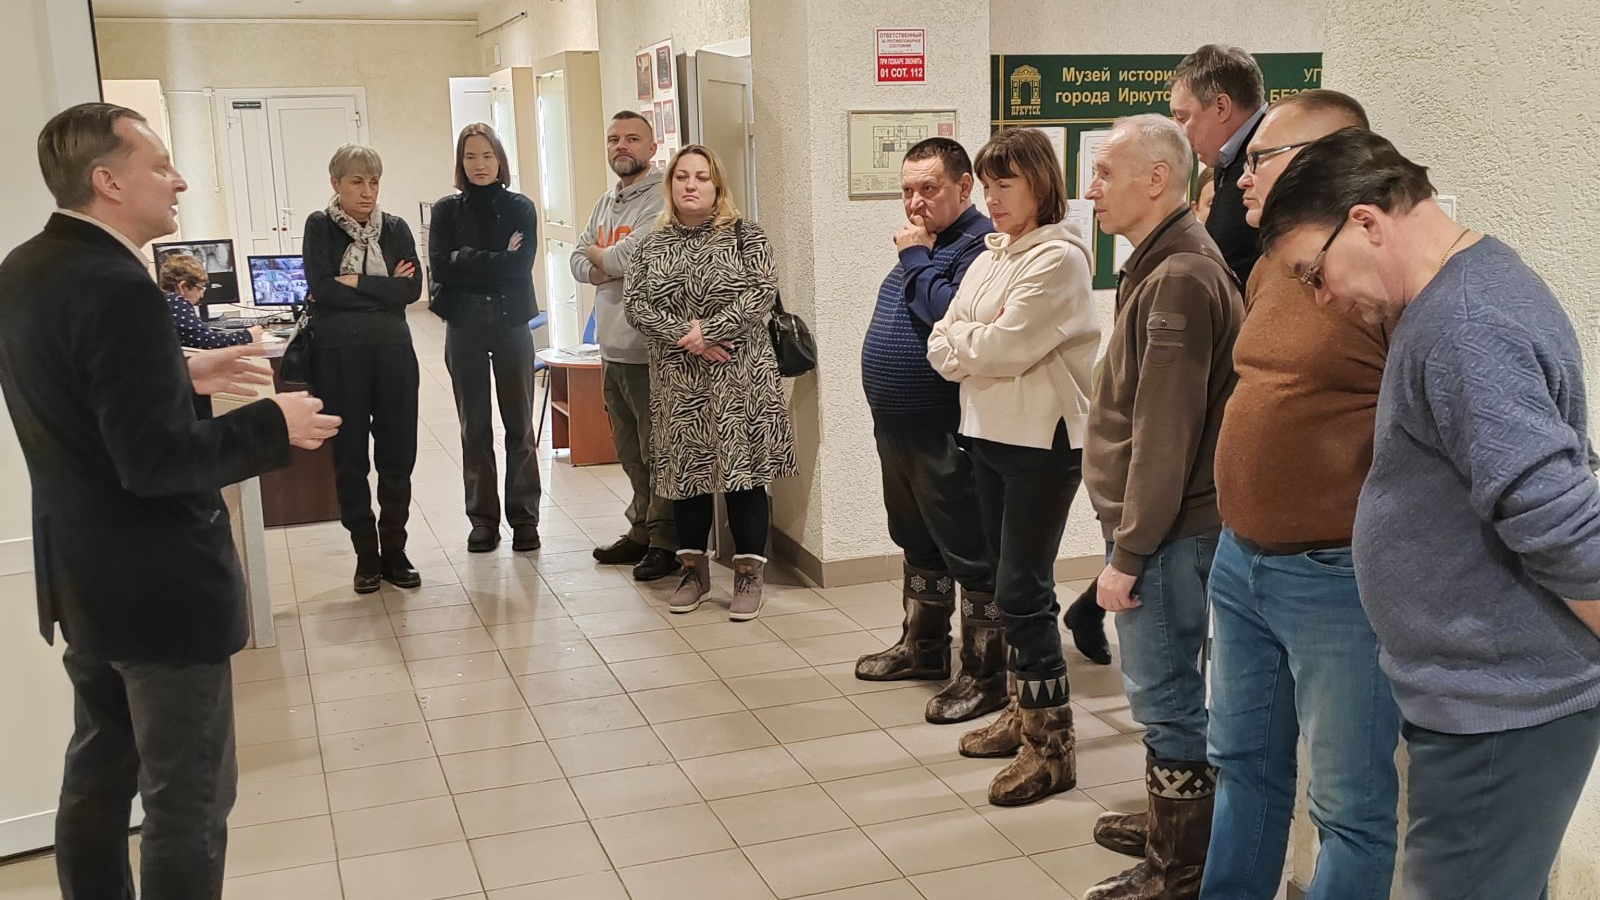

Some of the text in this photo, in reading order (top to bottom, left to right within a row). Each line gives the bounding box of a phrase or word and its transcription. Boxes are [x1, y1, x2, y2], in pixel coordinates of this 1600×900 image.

[880, 68, 923, 78] 01 СОТ. 112
[1062, 66, 1110, 86] Музей
[1055, 88, 1172, 106] города Иркутс
[1011, 105, 1041, 115] ИРКУТСК
